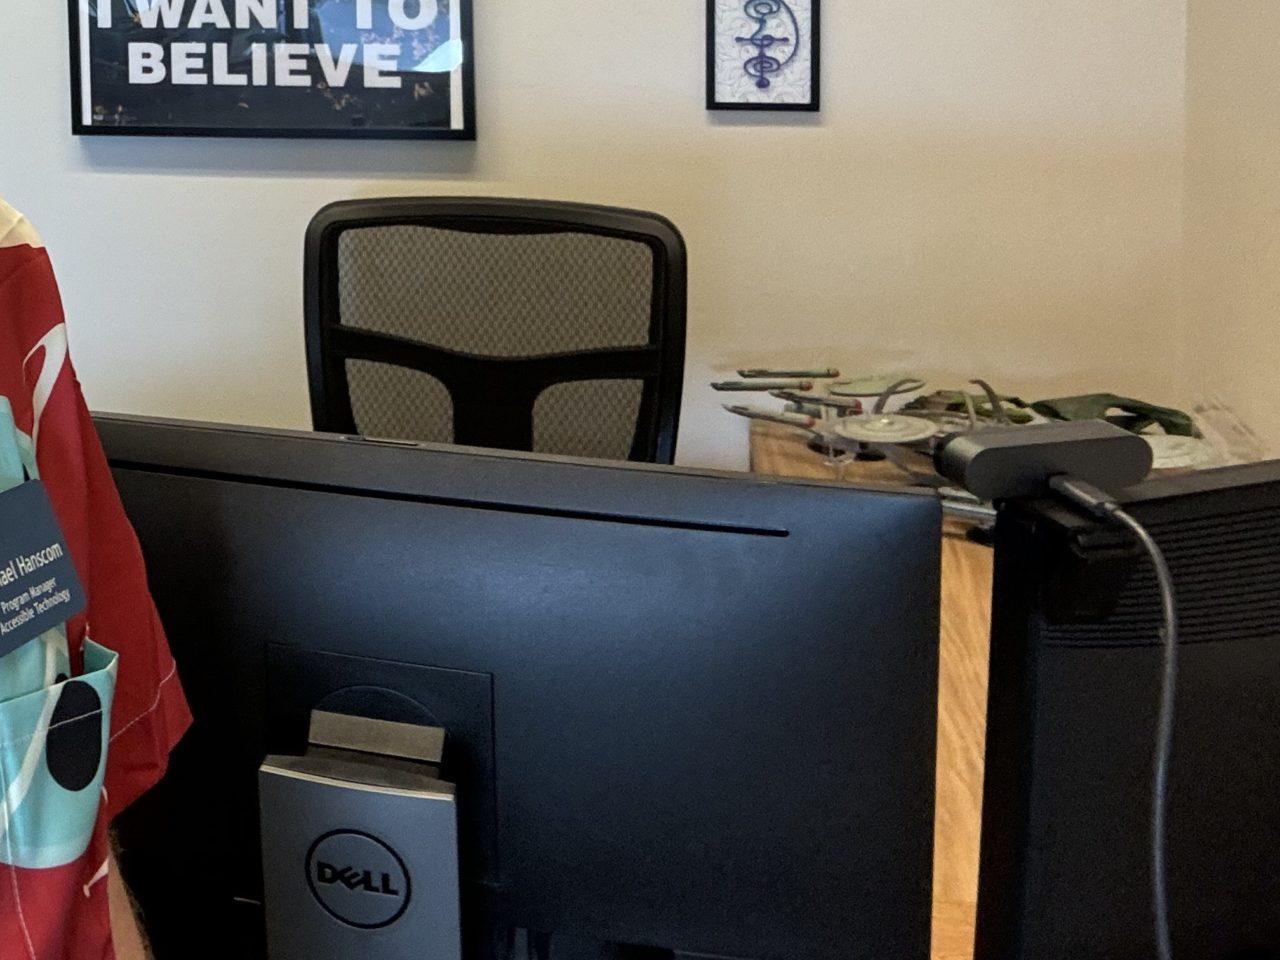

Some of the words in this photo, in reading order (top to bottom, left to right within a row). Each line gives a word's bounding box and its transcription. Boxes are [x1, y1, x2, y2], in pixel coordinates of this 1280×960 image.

[127, 41, 402, 89] BELIEVE
[16, 542, 63, 577] Hanscom
[0, 592, 30, 614] Program
[28, 577, 56, 599] Manager
[0, 607, 35, 635] Accessible
[33, 589, 70, 615] Technology
[316, 860, 400, 897] DELL
